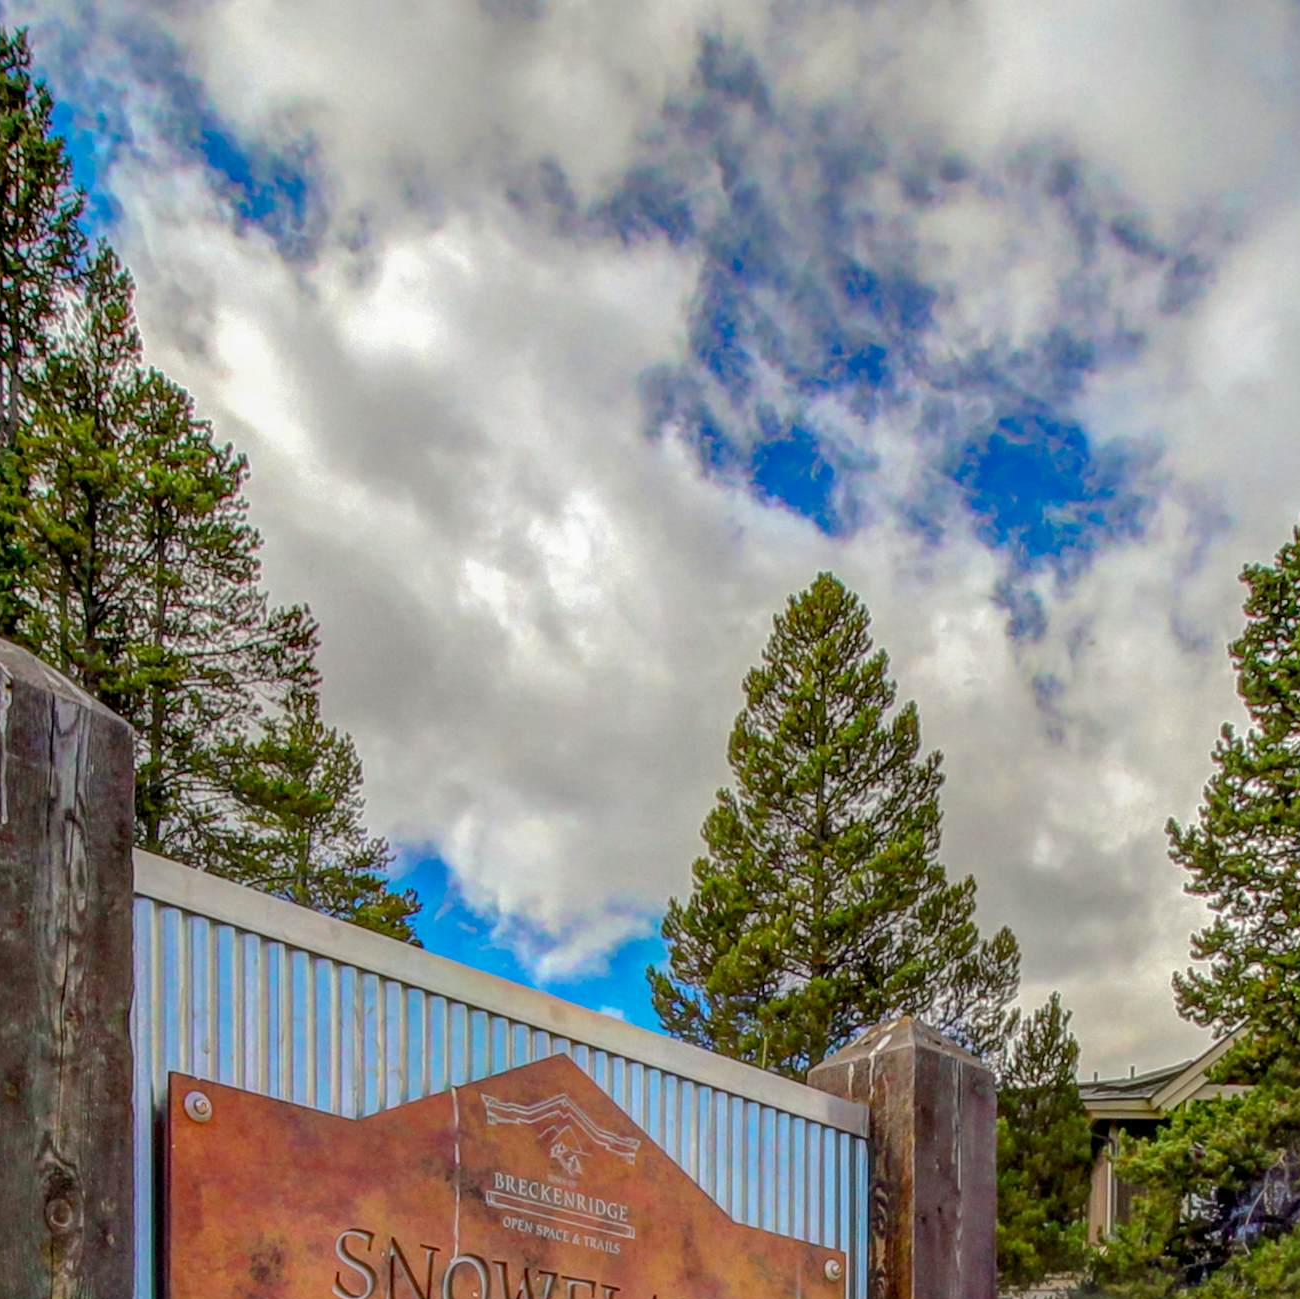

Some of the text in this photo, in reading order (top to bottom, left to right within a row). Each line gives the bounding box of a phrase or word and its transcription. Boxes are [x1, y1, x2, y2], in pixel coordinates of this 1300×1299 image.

[493, 1171, 628, 1222] BRECKENRIDGE
[502, 1215, 621, 1255] OPEN SPACE & TRAILS
